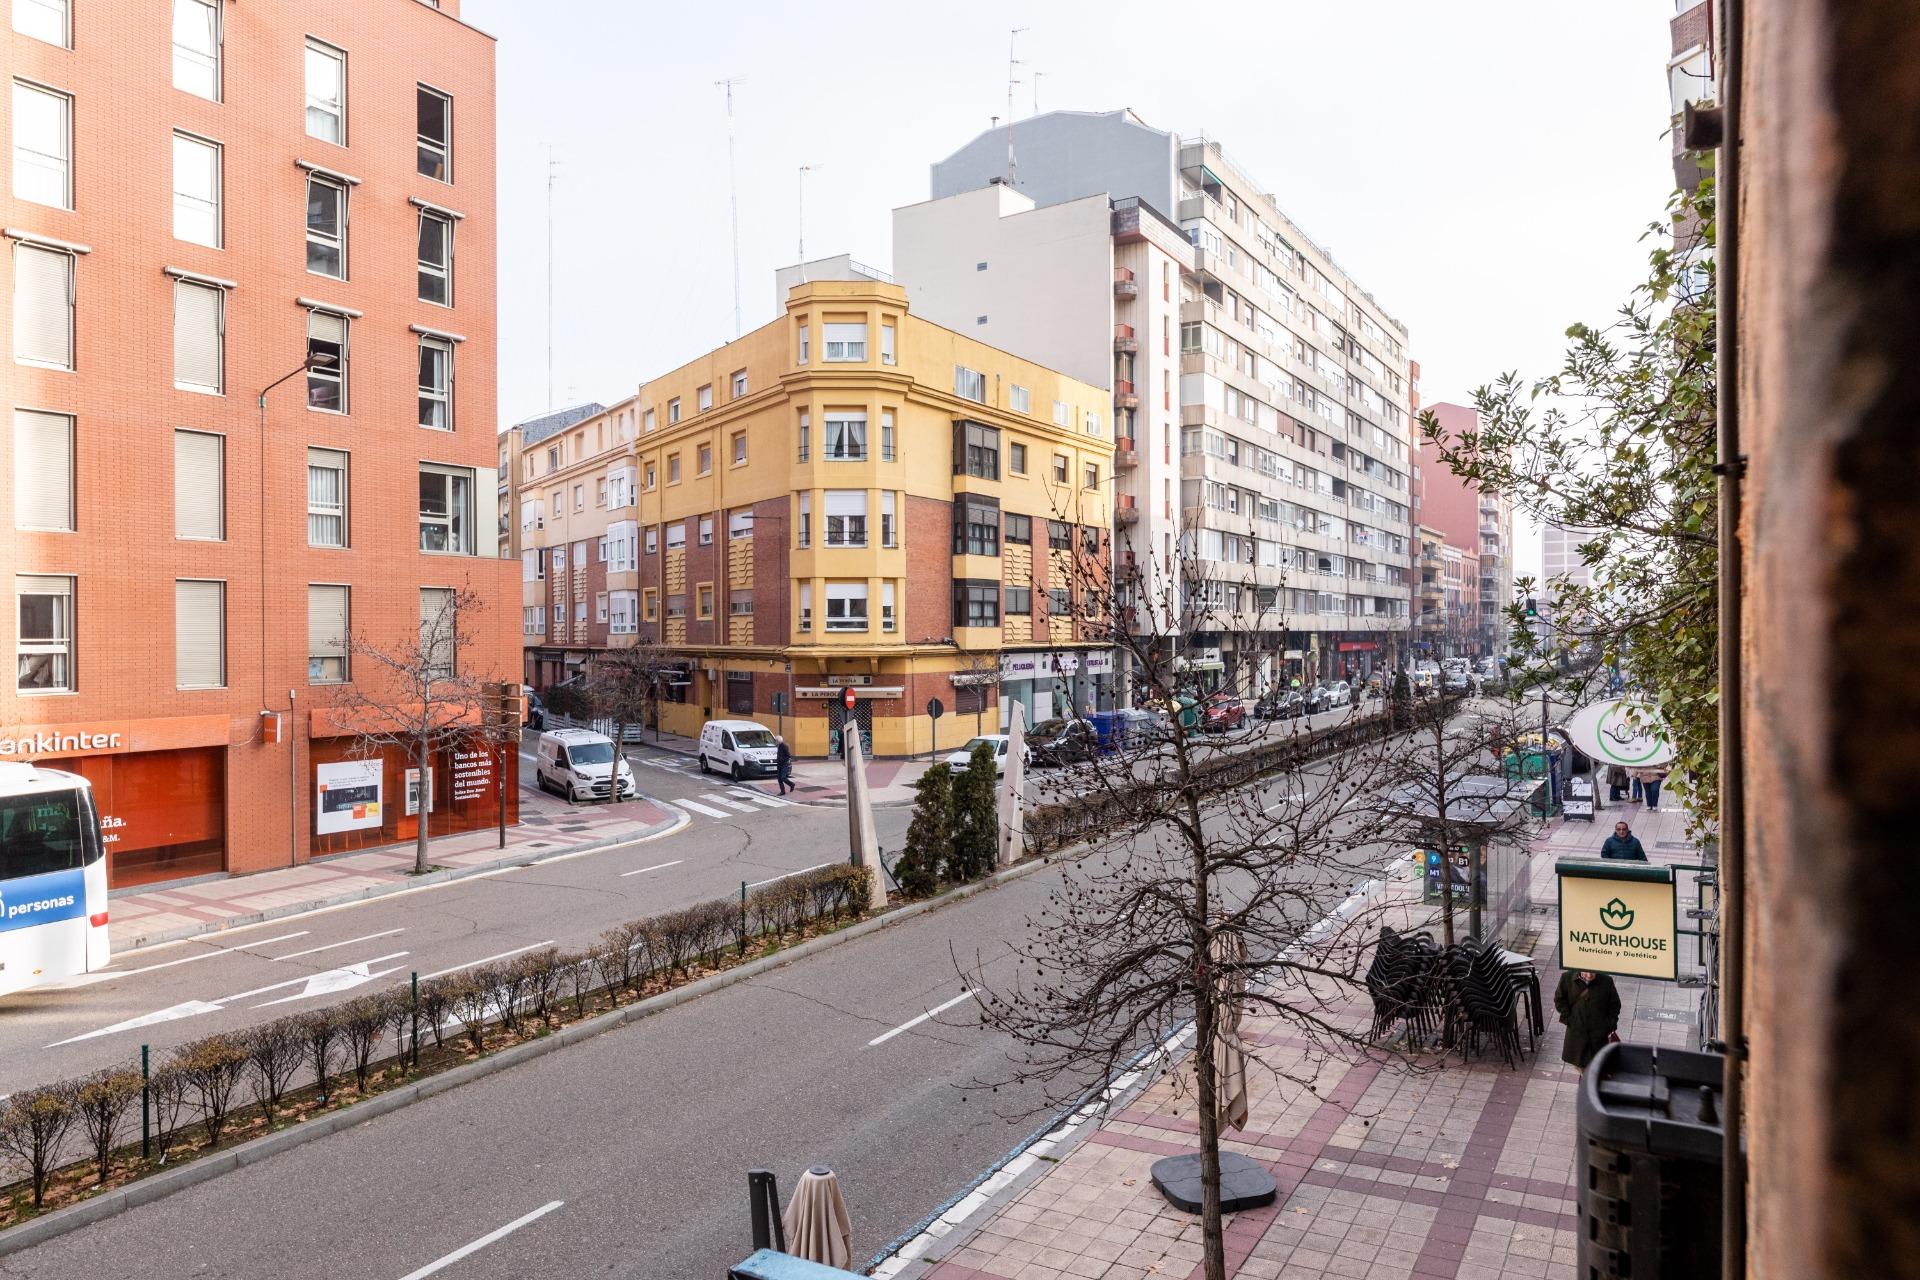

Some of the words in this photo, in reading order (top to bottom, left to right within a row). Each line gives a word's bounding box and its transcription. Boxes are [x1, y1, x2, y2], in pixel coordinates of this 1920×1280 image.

[455, 769, 490, 778] sostenibles
[467, 778, 490, 786] mundo.
[1458, 857, 1468, 865] B1
[1429, 869, 1440, 877] M1
[8, 895, 75, 919] personas
[1569, 931, 1667, 951] NATURHOUSE
[1578, 946, 1613, 955] Nutrición
[1623, 951, 1658, 960] Dietética
